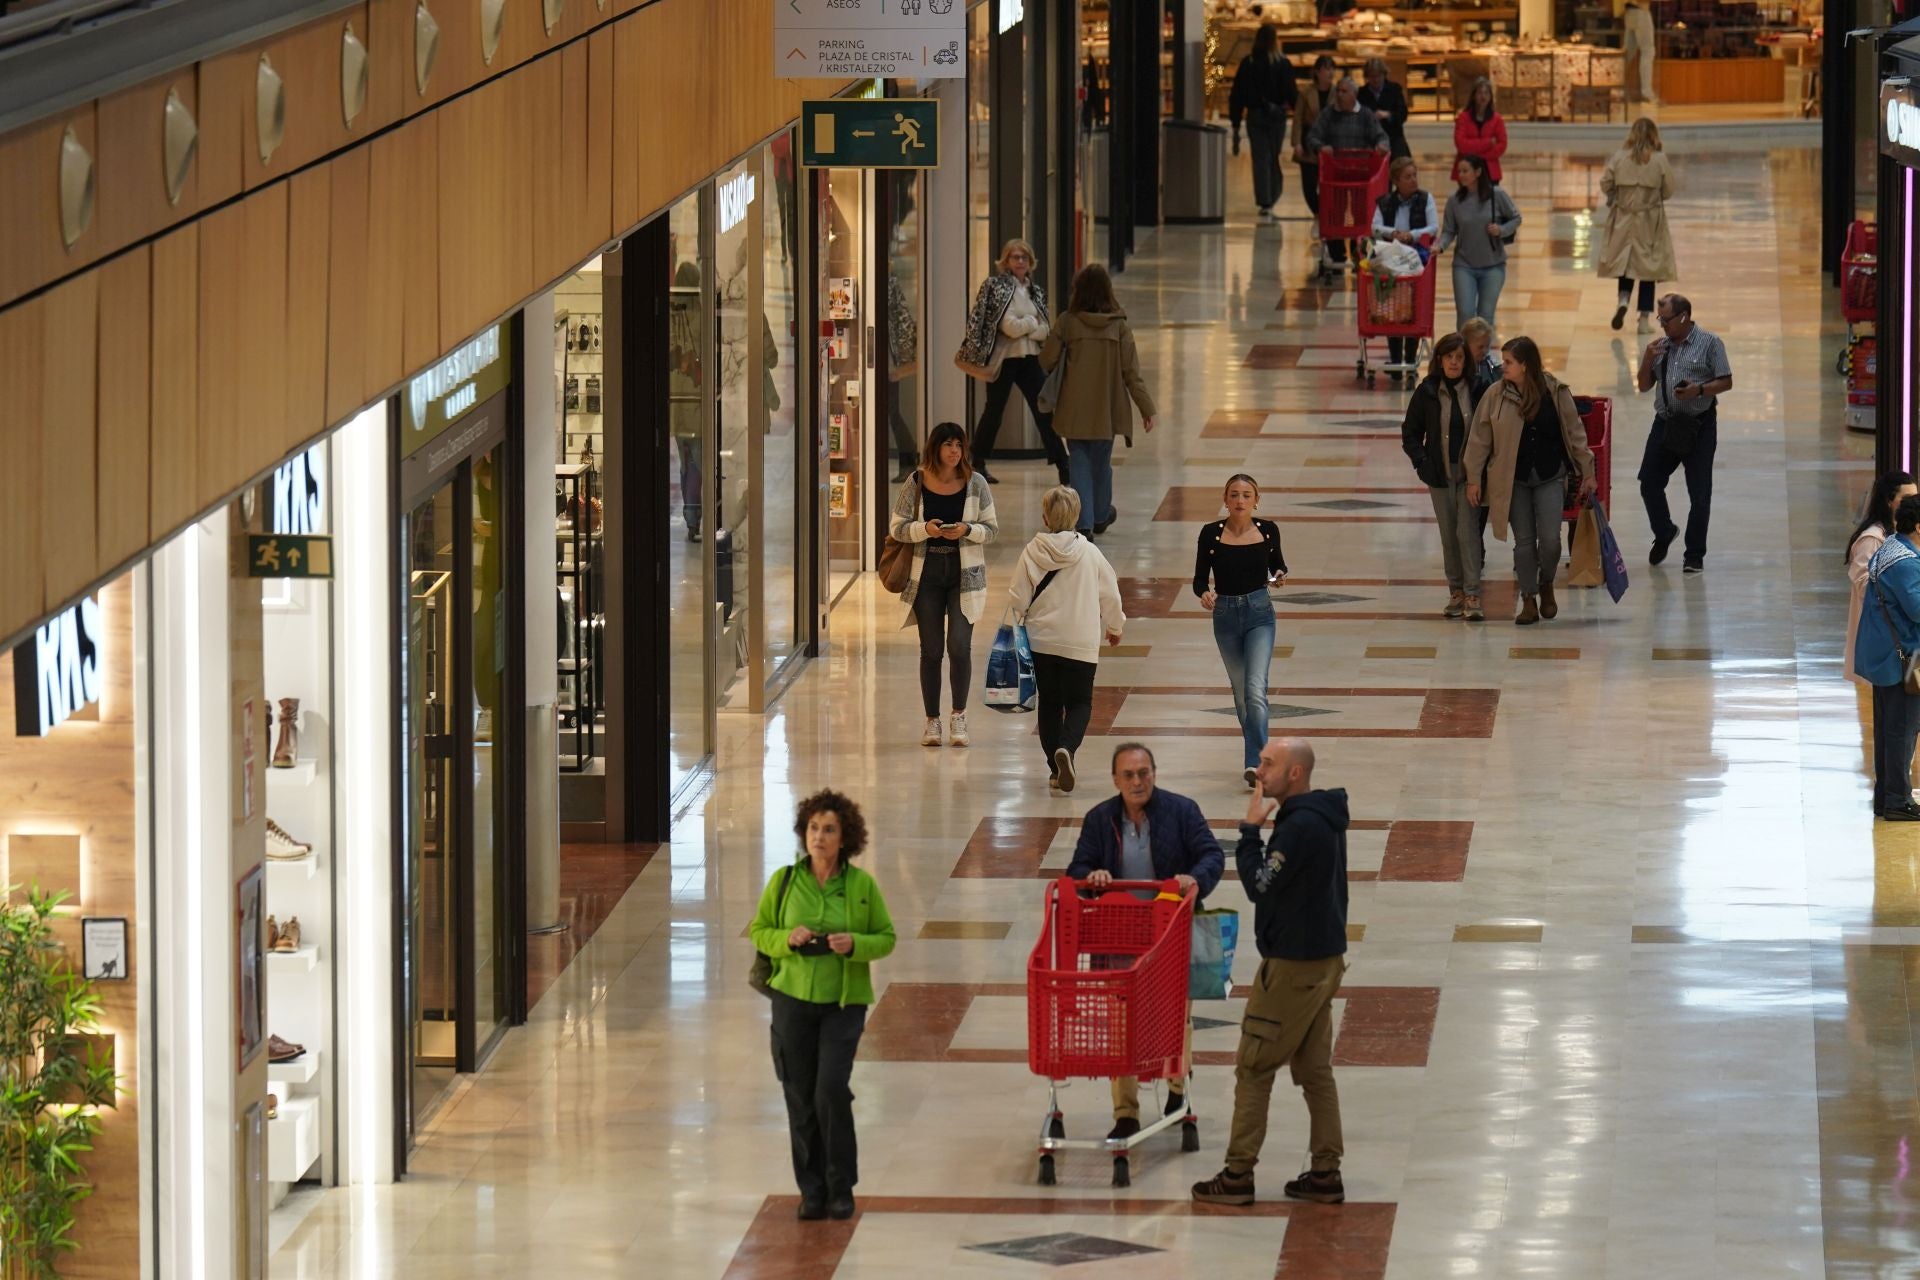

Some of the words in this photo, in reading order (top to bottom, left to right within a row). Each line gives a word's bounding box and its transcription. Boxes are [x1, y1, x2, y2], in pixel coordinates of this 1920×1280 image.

[826, 0, 861, 9] ASEOS
[819, 40, 865, 49] PARKING
[819, 52, 850, 61] PLAZA
[854, 52, 869, 61] DE
[871, 52, 914, 61] CRISTAL
[827, 64, 896, 73] KRISTALEZKO
